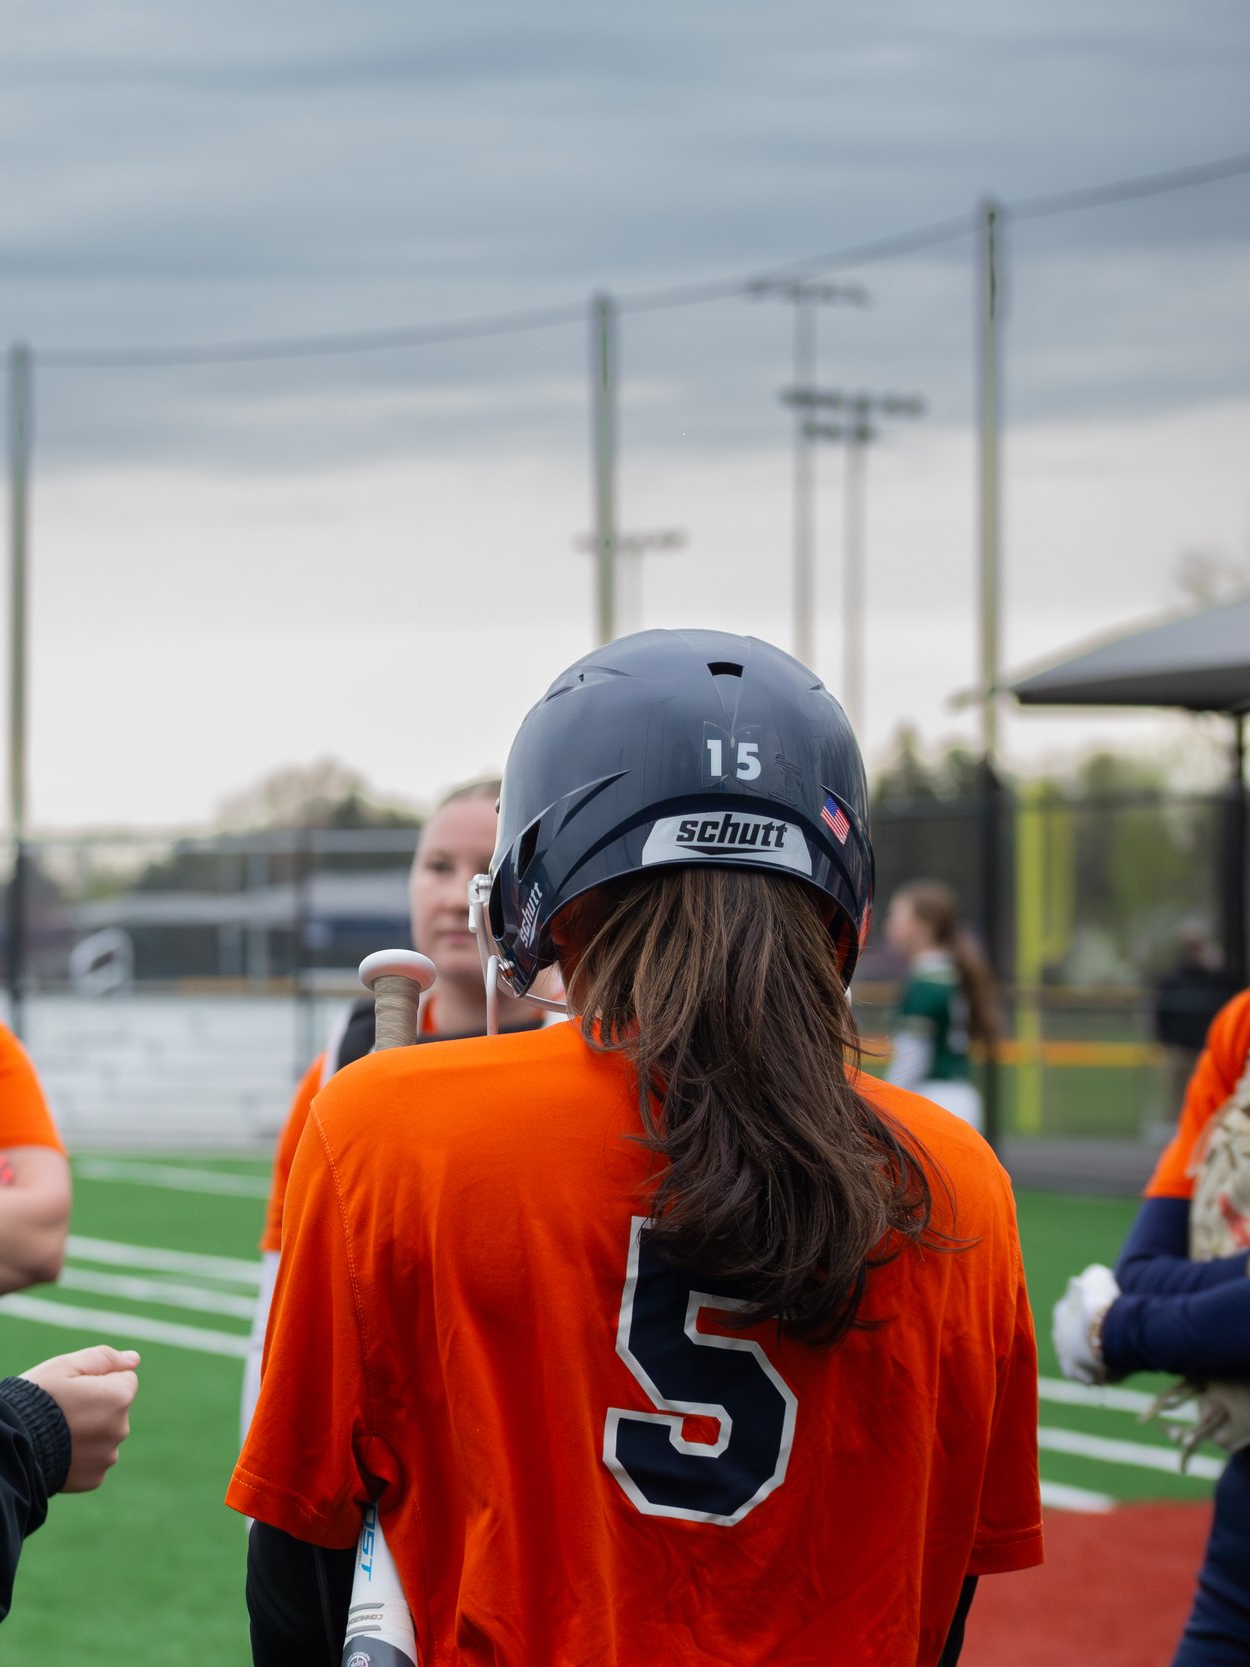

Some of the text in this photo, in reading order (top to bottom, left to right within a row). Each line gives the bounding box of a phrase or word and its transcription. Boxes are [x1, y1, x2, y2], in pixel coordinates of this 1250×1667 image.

[707, 739, 761, 781] 15
[676, 813, 787, 848] schutt
[603, 1216, 798, 1526] 5
